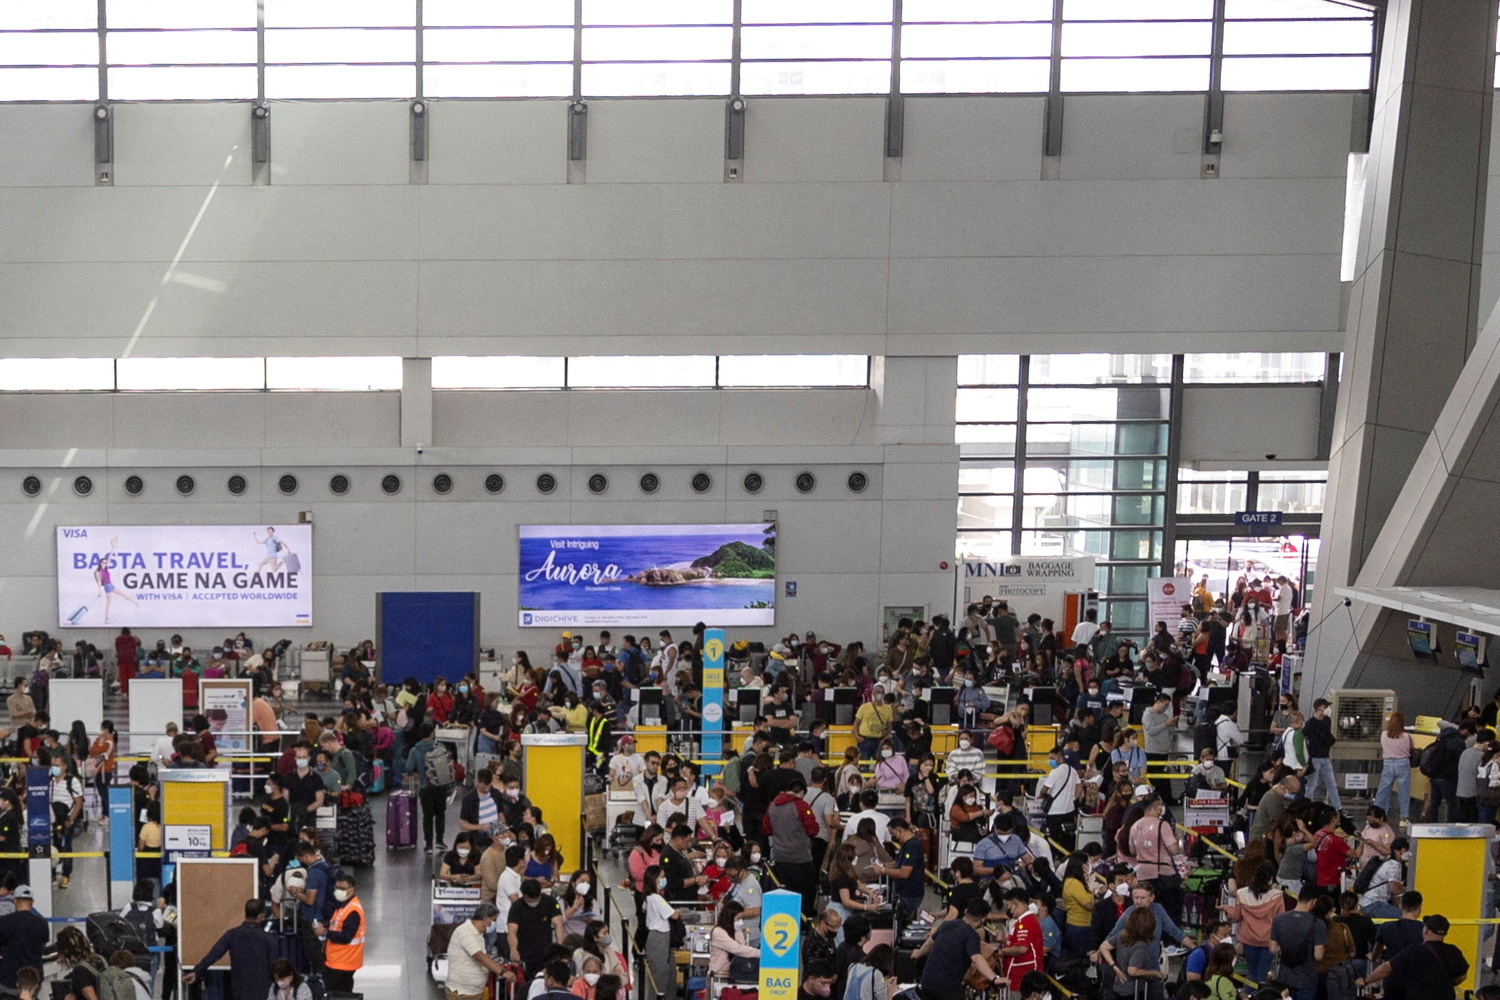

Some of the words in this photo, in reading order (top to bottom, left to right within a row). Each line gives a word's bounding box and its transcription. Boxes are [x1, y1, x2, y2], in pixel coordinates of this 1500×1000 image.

[1241, 513, 1268, 523] GATE
[1270, 514, 1277, 522] 2
[63, 529, 88, 538] VISA
[550, 540, 565, 549] Visit
[567, 540, 599, 550] Intriguing
[73, 552, 147, 569] BASTA
[153, 552, 249, 571] TRAVEL,
[1028, 562, 1074, 570] BAGGAGE
[525, 550, 622, 585] Aurora
[1026, 569, 1075, 577] WRAPPING
[123, 572, 188, 589] GAME
[195, 572, 227, 589] NA
[233, 572, 298, 589] GAME
[239, 592, 298, 600] WORLDWIDE
[534, 615, 579, 623] DIGICHIVE
[710, 647, 717, 658] 1
[188, 836, 199, 847] 10
[773, 920, 789, 928] Step
[773, 929, 789, 950] 2
[765, 977, 792, 988] BAG
